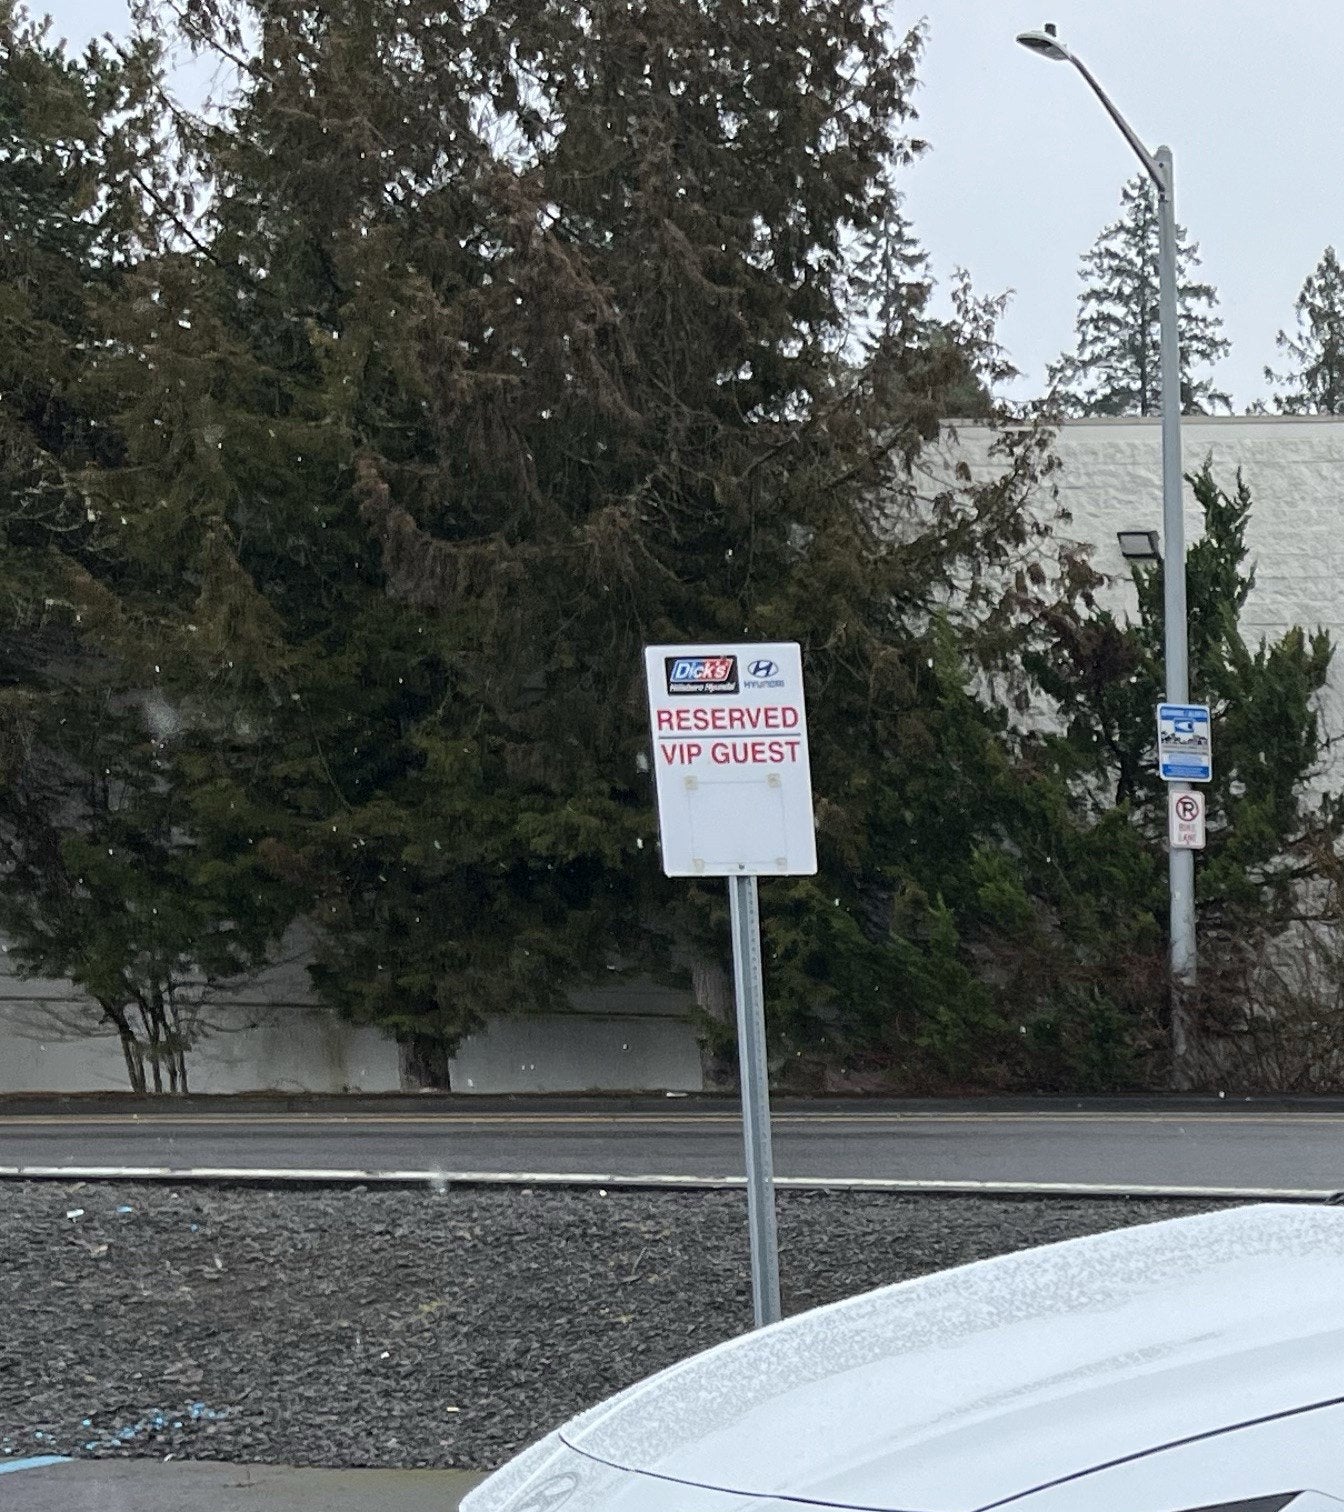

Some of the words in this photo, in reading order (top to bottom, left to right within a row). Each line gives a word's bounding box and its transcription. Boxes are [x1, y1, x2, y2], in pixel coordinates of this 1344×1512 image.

[675, 661, 727, 679] Dick's
[657, 706, 799, 731] RESERVED
[661, 744, 702, 765] VIP
[711, 741, 801, 765] GUEST
